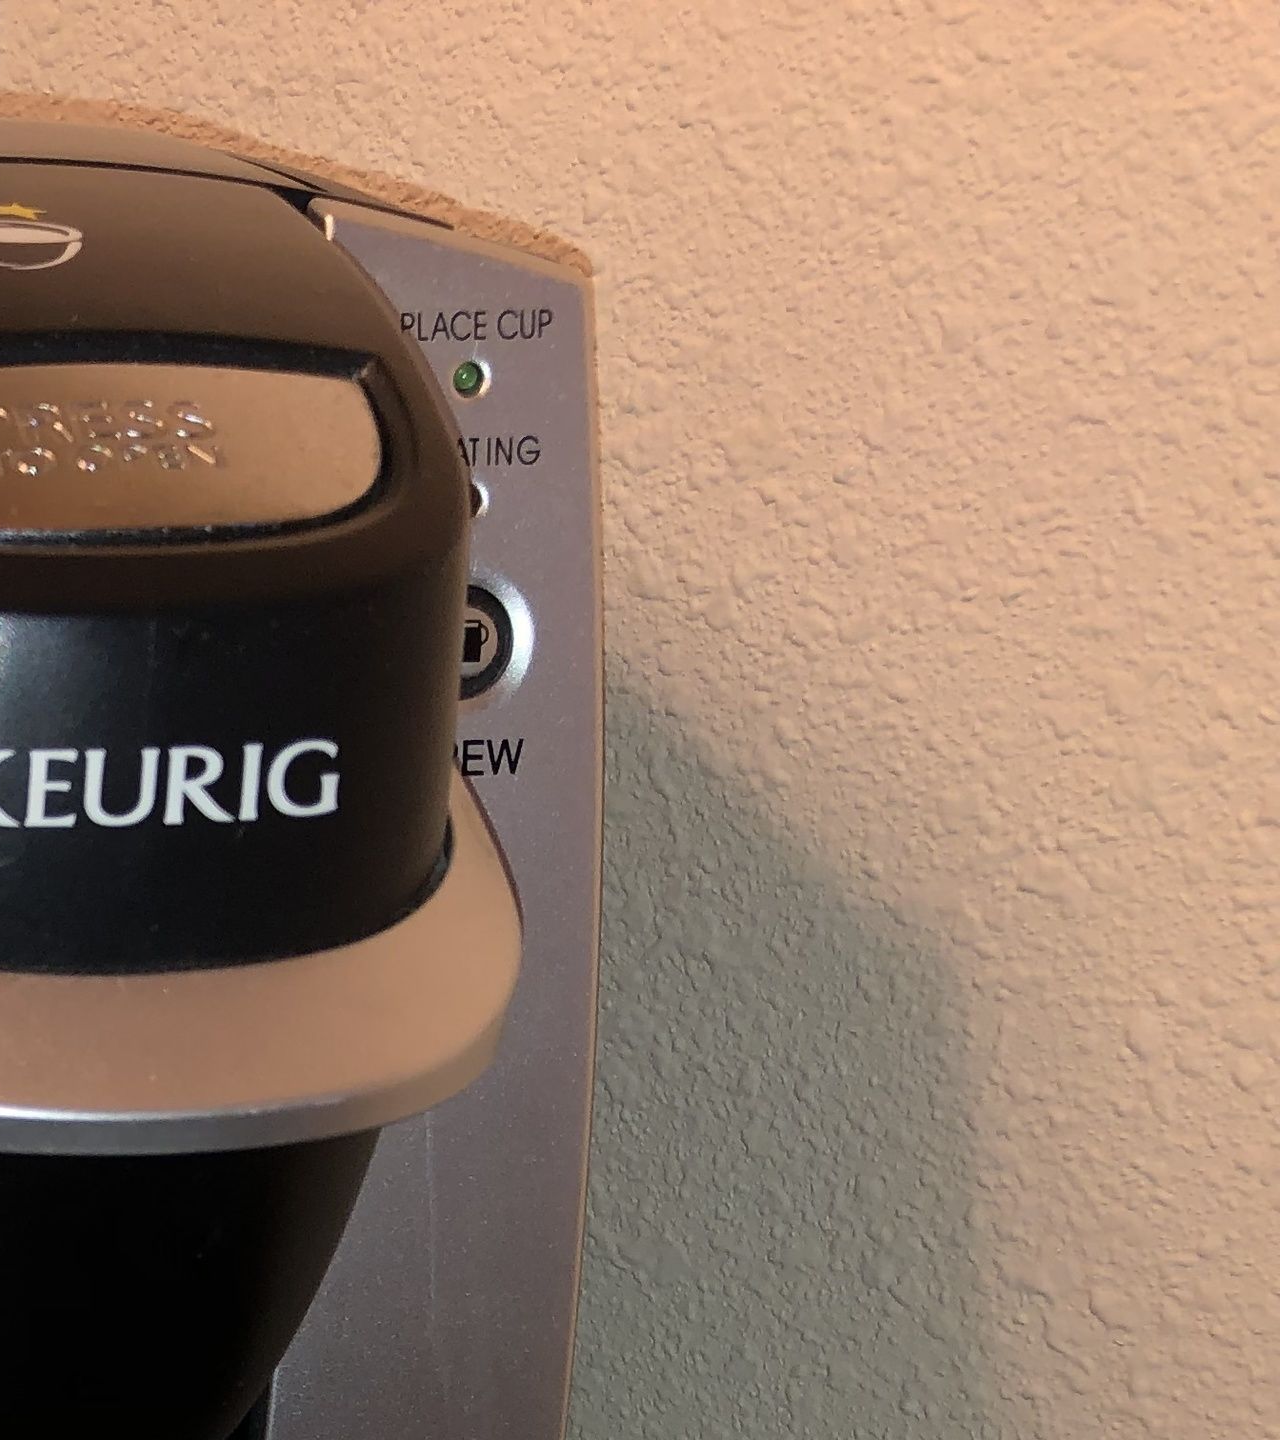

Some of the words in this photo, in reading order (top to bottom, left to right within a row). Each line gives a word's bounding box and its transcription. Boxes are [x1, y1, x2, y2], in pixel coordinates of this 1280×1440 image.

[400, 310, 489, 342] PLACE
[496, 308, 553, 340] CUP
[456, 435, 542, 467] ATING
[454, 738, 525, 777] EW
